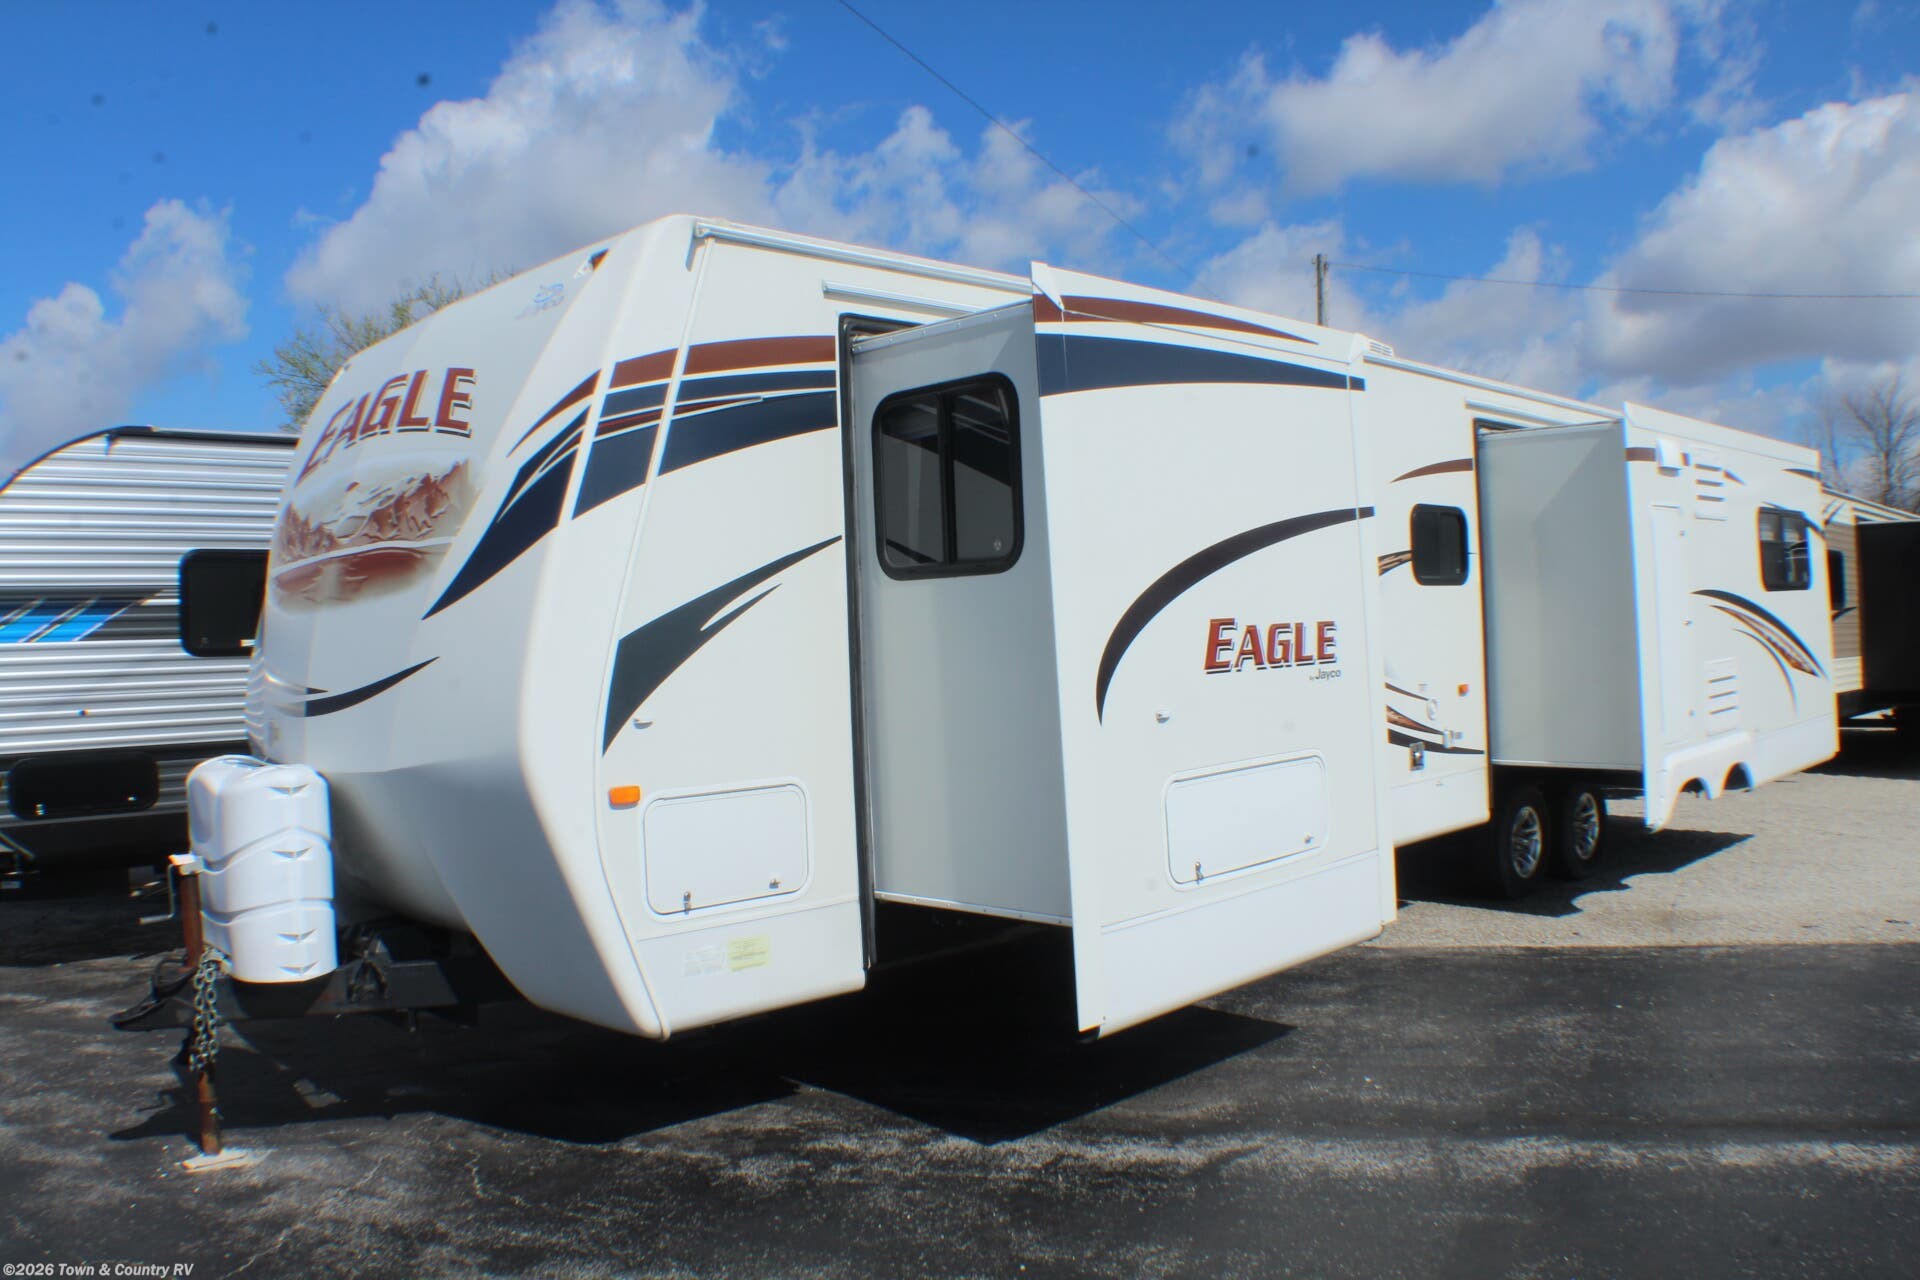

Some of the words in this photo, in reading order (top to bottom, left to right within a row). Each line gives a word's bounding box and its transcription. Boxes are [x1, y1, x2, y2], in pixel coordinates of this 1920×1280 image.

[296, 366, 476, 484] EAGLE
[1203, 617, 1337, 675] EAGLE
[1315, 667, 1342, 681] Jayco
